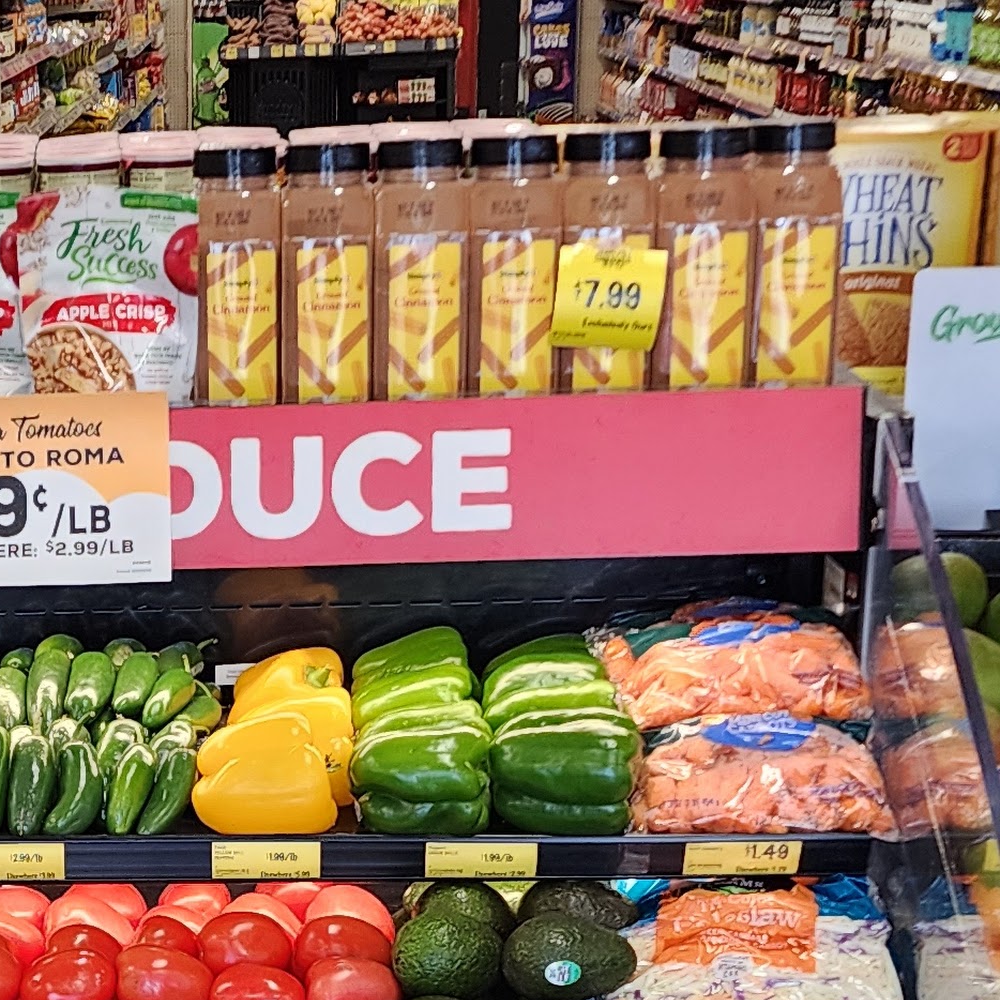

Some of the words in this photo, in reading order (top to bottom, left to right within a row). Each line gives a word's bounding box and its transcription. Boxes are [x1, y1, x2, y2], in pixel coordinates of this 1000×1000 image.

[843, 172, 944, 215] HEAT
[56, 218, 152, 260] Fresh
[840, 211, 938, 270] HINS
[67, 246, 158, 282] Success
[56, 303, 108, 322] APPLE
[115, 303, 168, 324] CRISP
[10, 414, 104, 444] Tomatoes
[46, 447, 126, 468] ROMA
[45, 537, 135, 558] $2.99/LB
